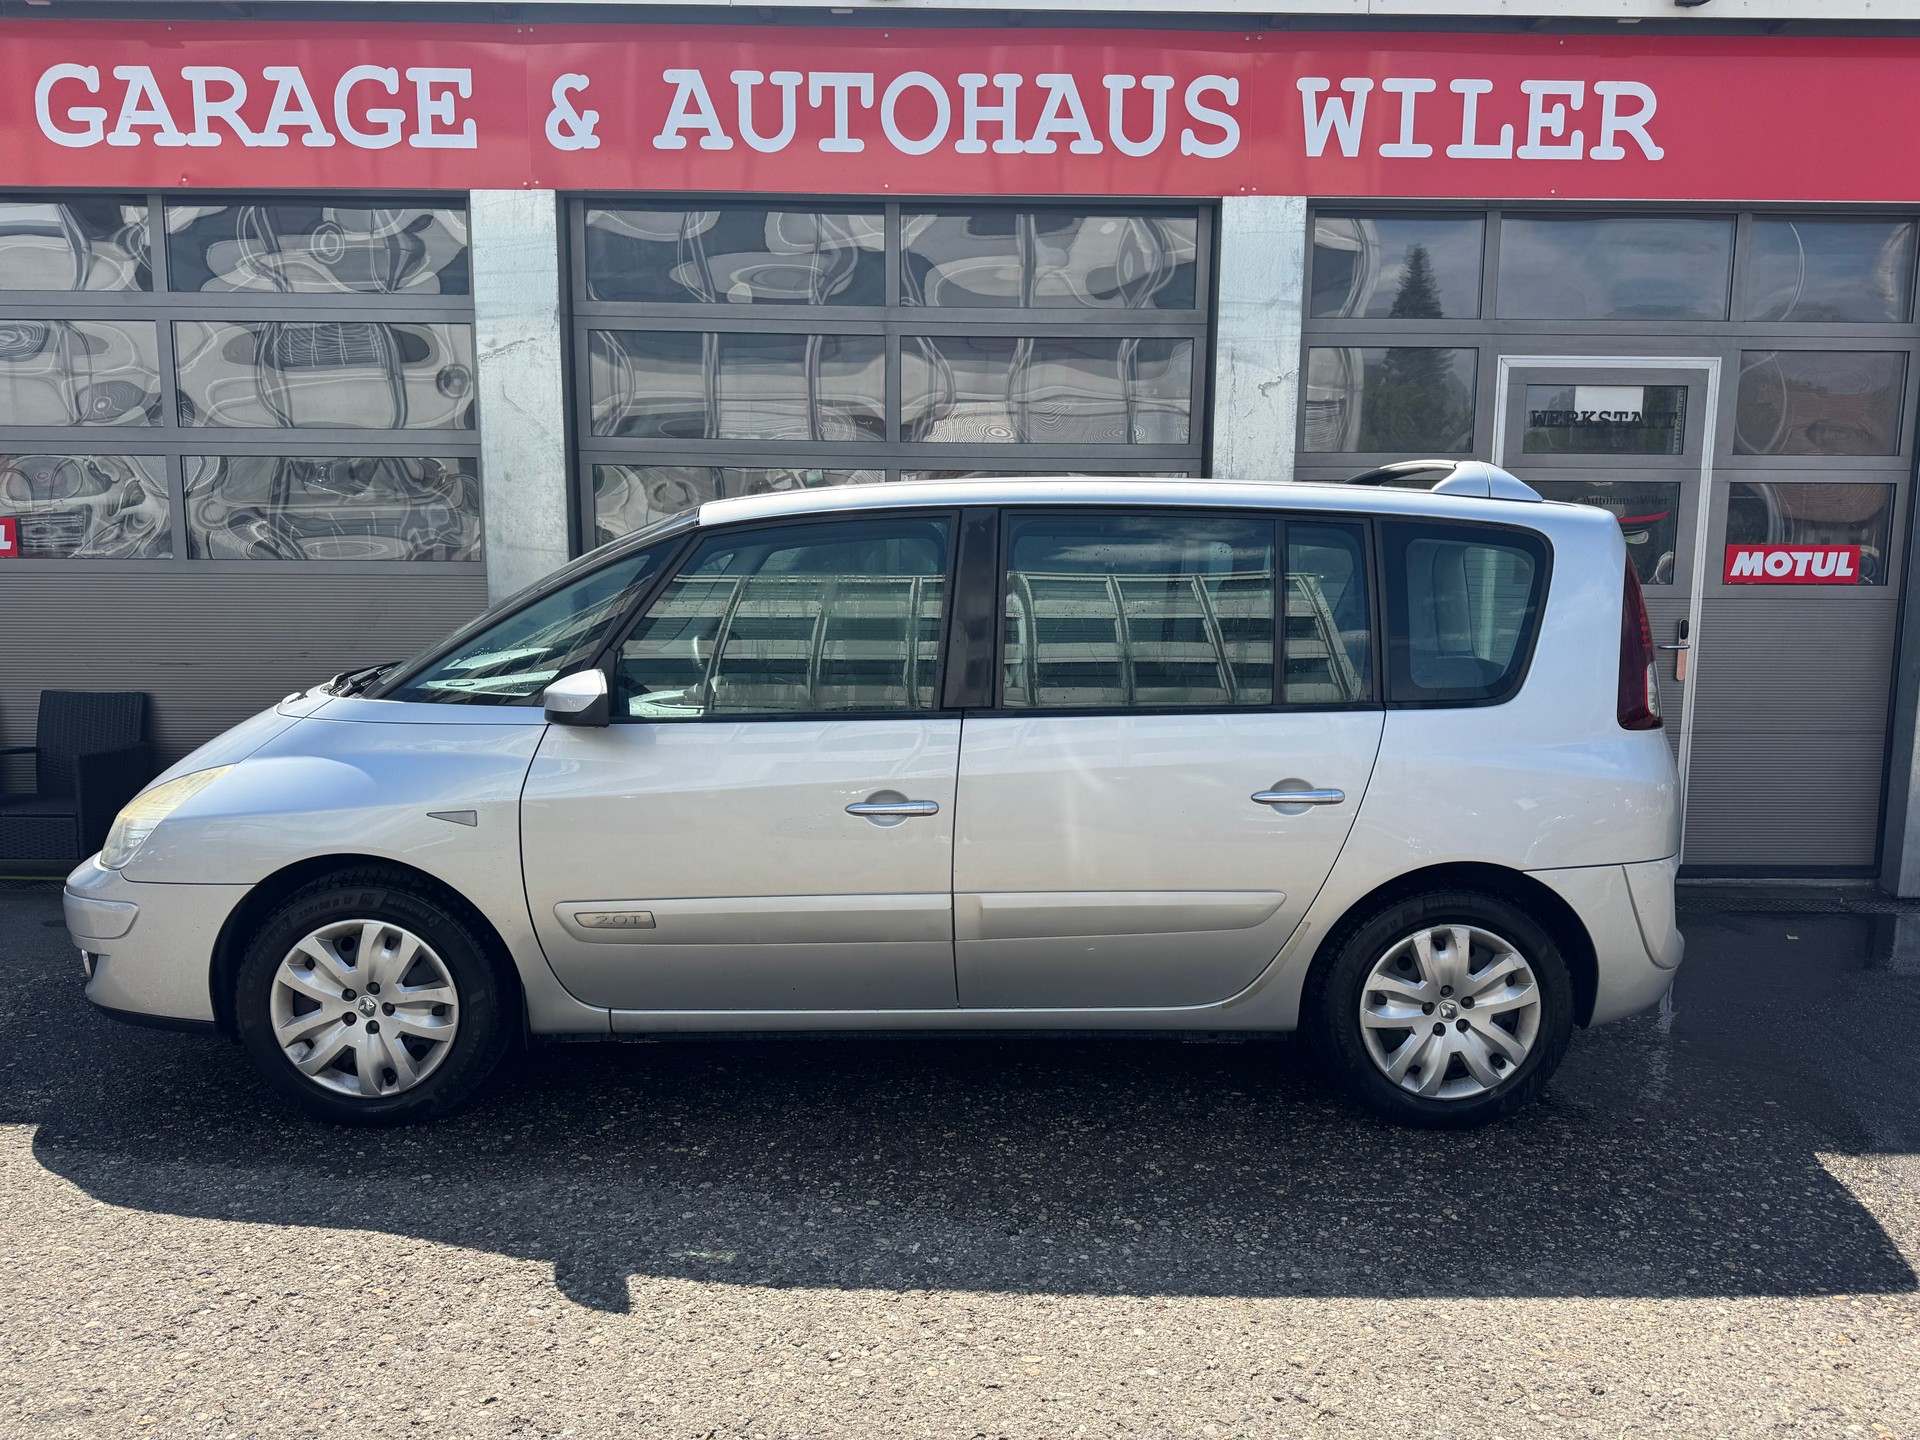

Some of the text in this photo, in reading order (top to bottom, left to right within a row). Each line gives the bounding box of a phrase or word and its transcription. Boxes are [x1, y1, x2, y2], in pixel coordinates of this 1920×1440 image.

[34, 62, 1665, 162] GARAGE & AUTOHAUS WILER
[1529, 409, 1678, 429] WERKSTATT
[1640, 495, 1670, 506] Wiler
[1729, 551, 1854, 577] MOTUL
